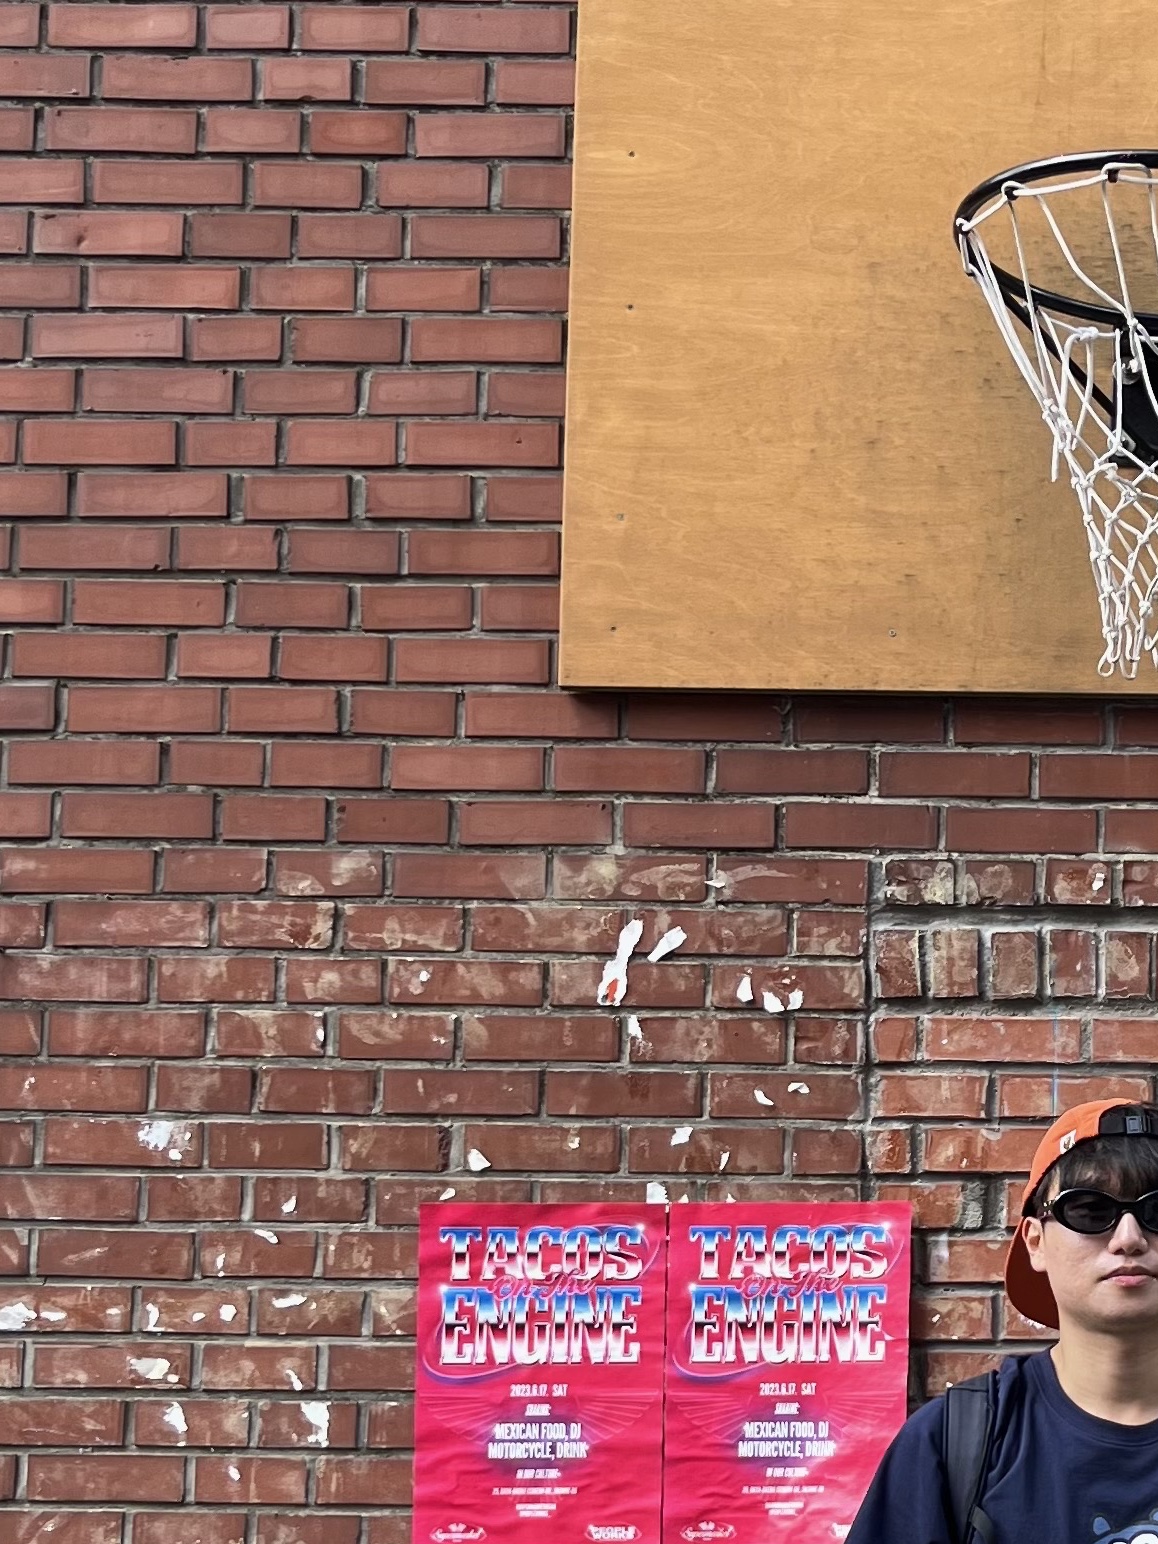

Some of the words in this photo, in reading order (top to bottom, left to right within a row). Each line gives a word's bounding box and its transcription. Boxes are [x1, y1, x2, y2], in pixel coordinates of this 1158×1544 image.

[439, 1225, 643, 1281] TACOS
[689, 1224, 888, 1280] TACOS
[439, 1285, 643, 1366] ENGINE
[689, 1284, 887, 1364] ENGINE
[552, 1384, 569, 1397] SAT
[801, 1382, 817, 1395] SAT
[569, 1423, 582, 1440] DJ
[818, 1421, 829, 1438] DJ
